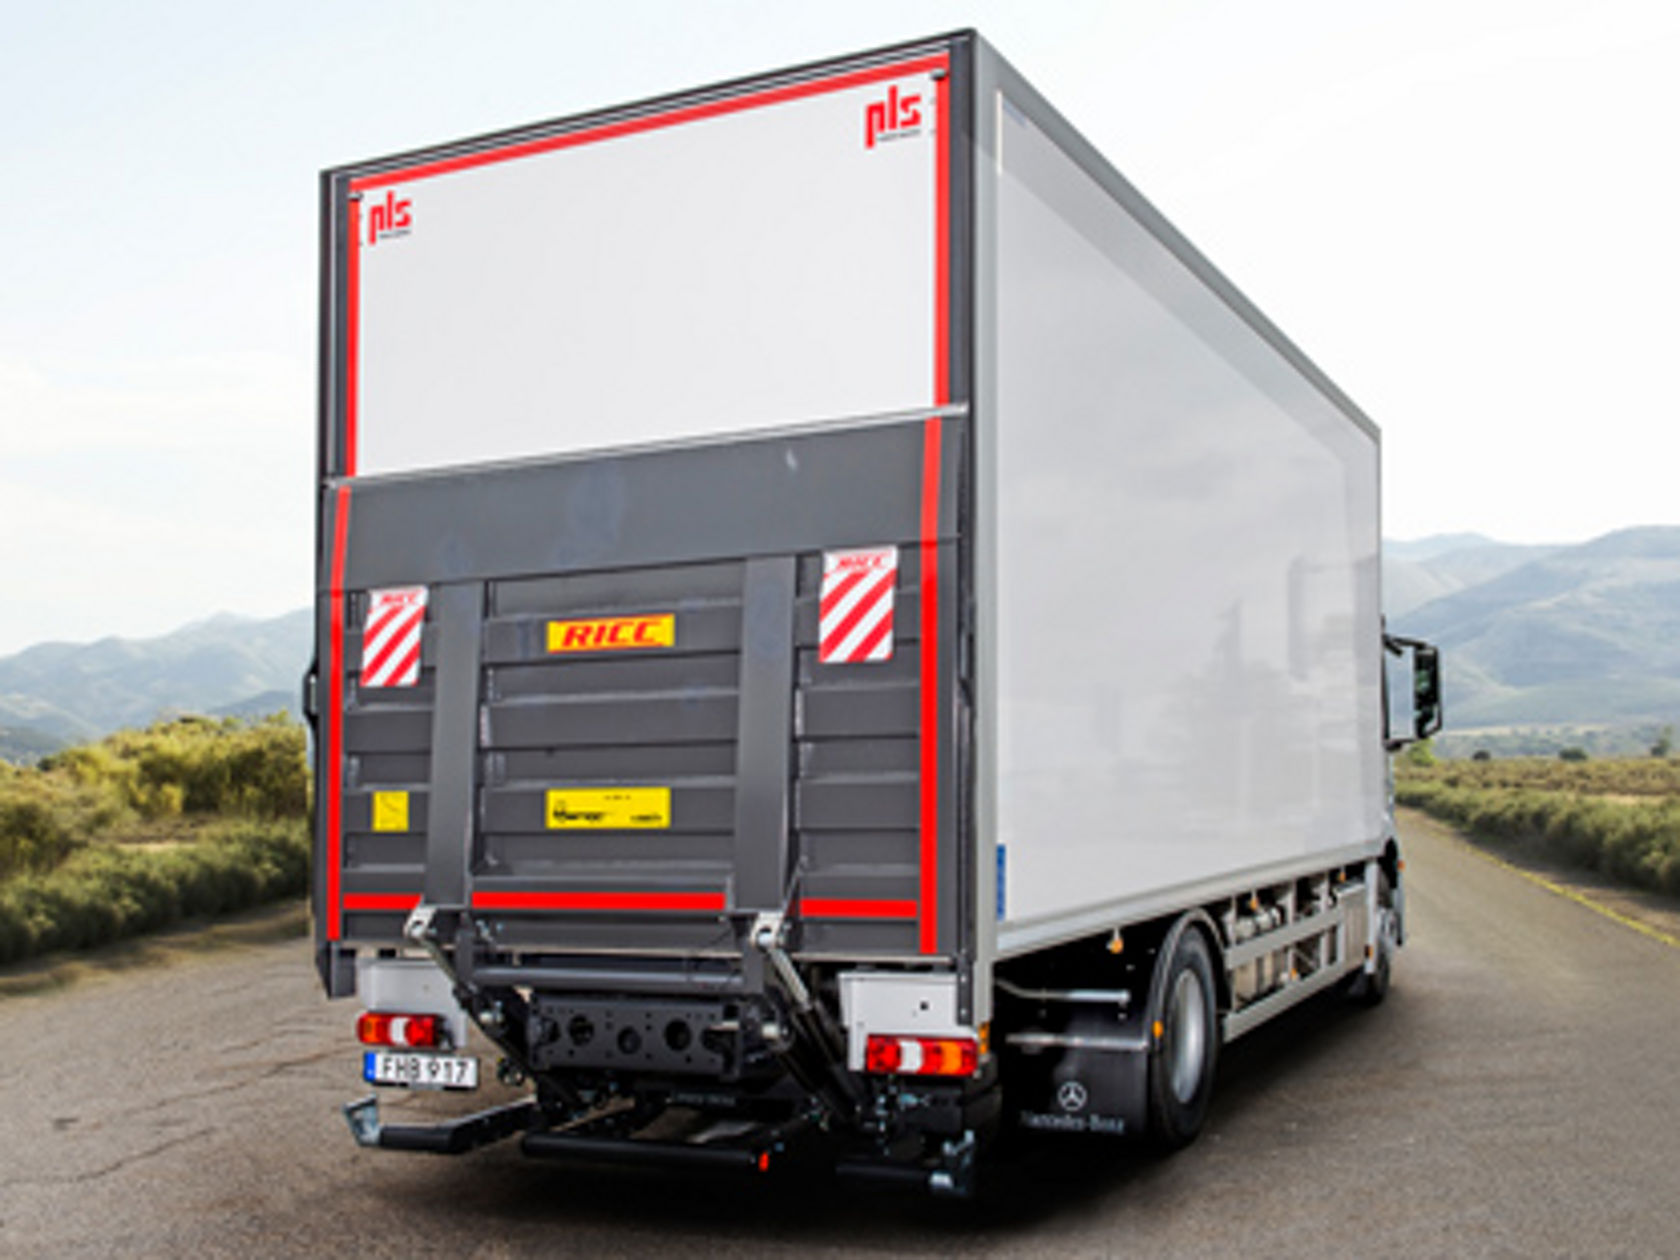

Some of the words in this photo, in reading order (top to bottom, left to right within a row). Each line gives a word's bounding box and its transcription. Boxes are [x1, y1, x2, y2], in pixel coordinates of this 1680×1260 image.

[865, 84, 921, 149] pls
[368, 190, 412, 245] pls
[561, 621, 662, 646] RICC
[427, 1060, 468, 1083] 917
